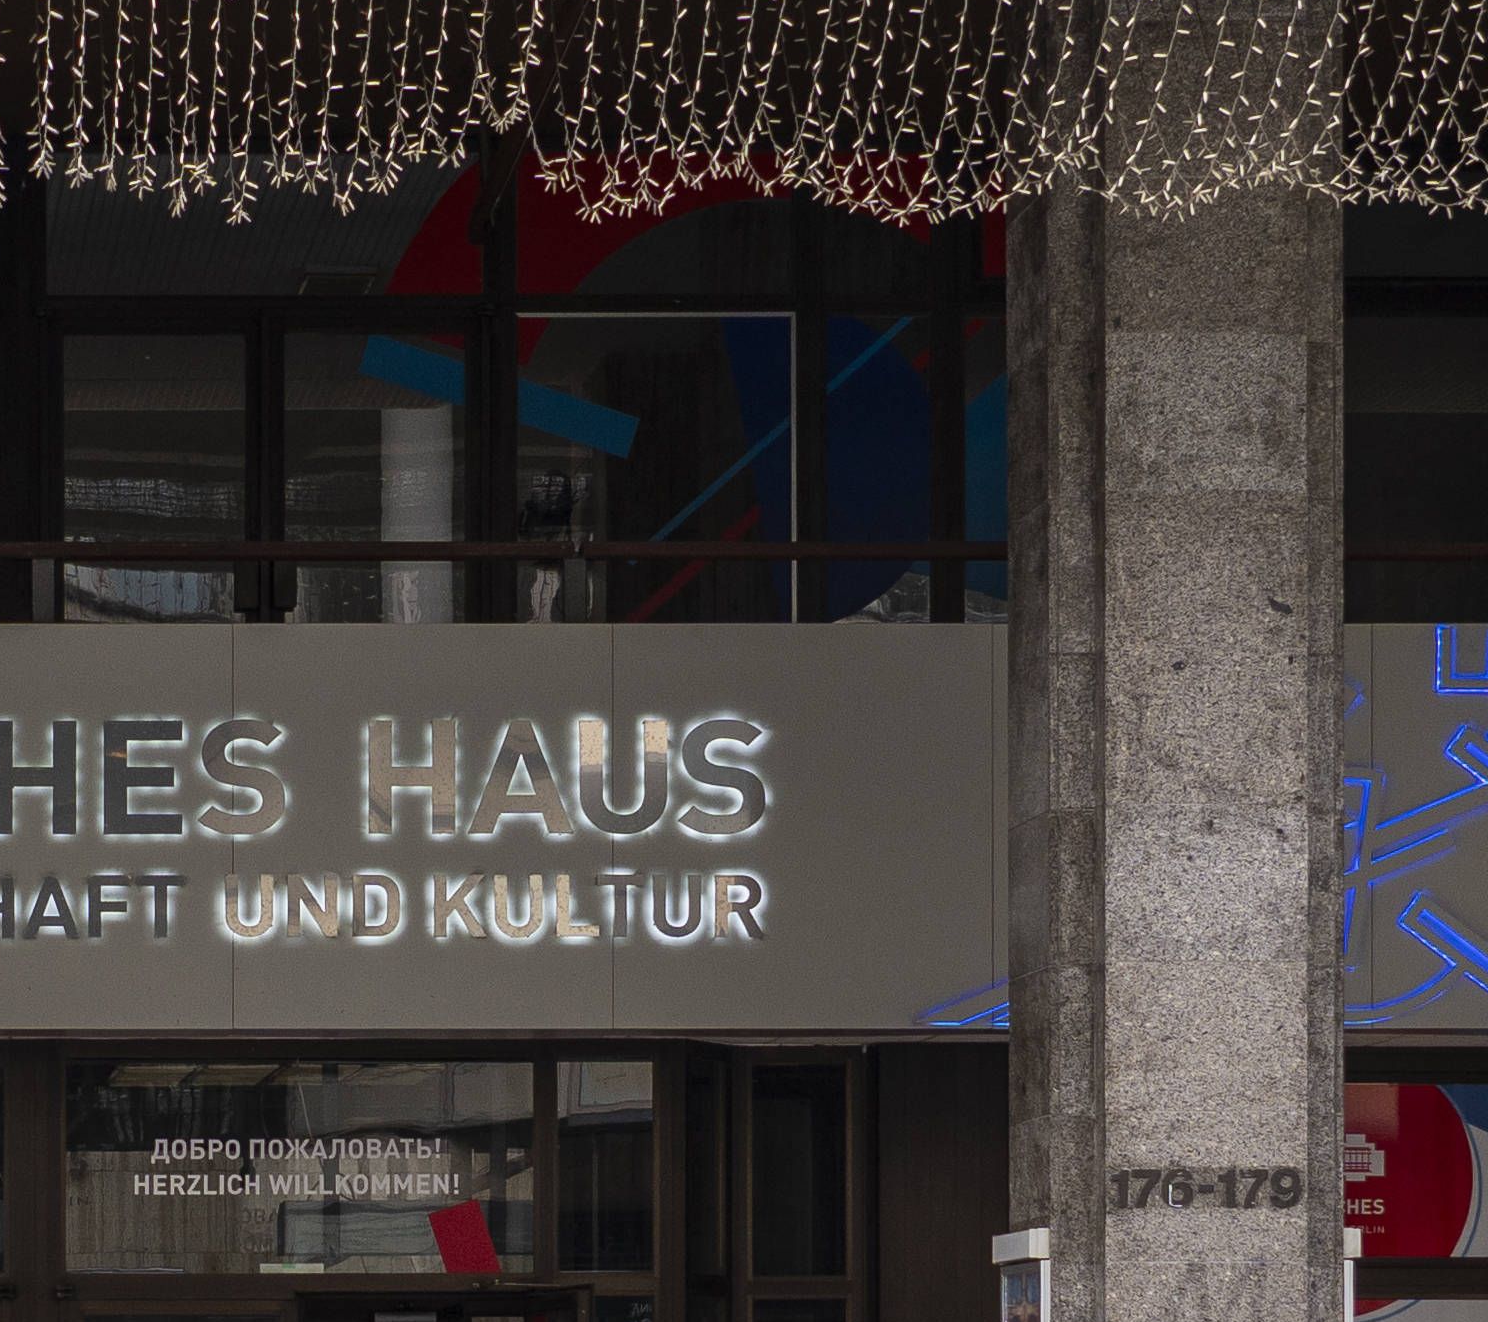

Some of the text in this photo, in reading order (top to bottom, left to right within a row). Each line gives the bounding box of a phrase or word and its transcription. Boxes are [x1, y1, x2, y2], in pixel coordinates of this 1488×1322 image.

[368, 718, 766, 836] HAUS
[224, 874, 401, 939] UND
[433, 873, 764, 940] KULTUR
[150, 1138, 441, 1164] ДОБРО ПОЖАЛОВАТЬ!
[133, 1174, 460, 1196] HERZLICH WILLKOMMEN!
[1110, 1167, 1303, 1210] 176-179
